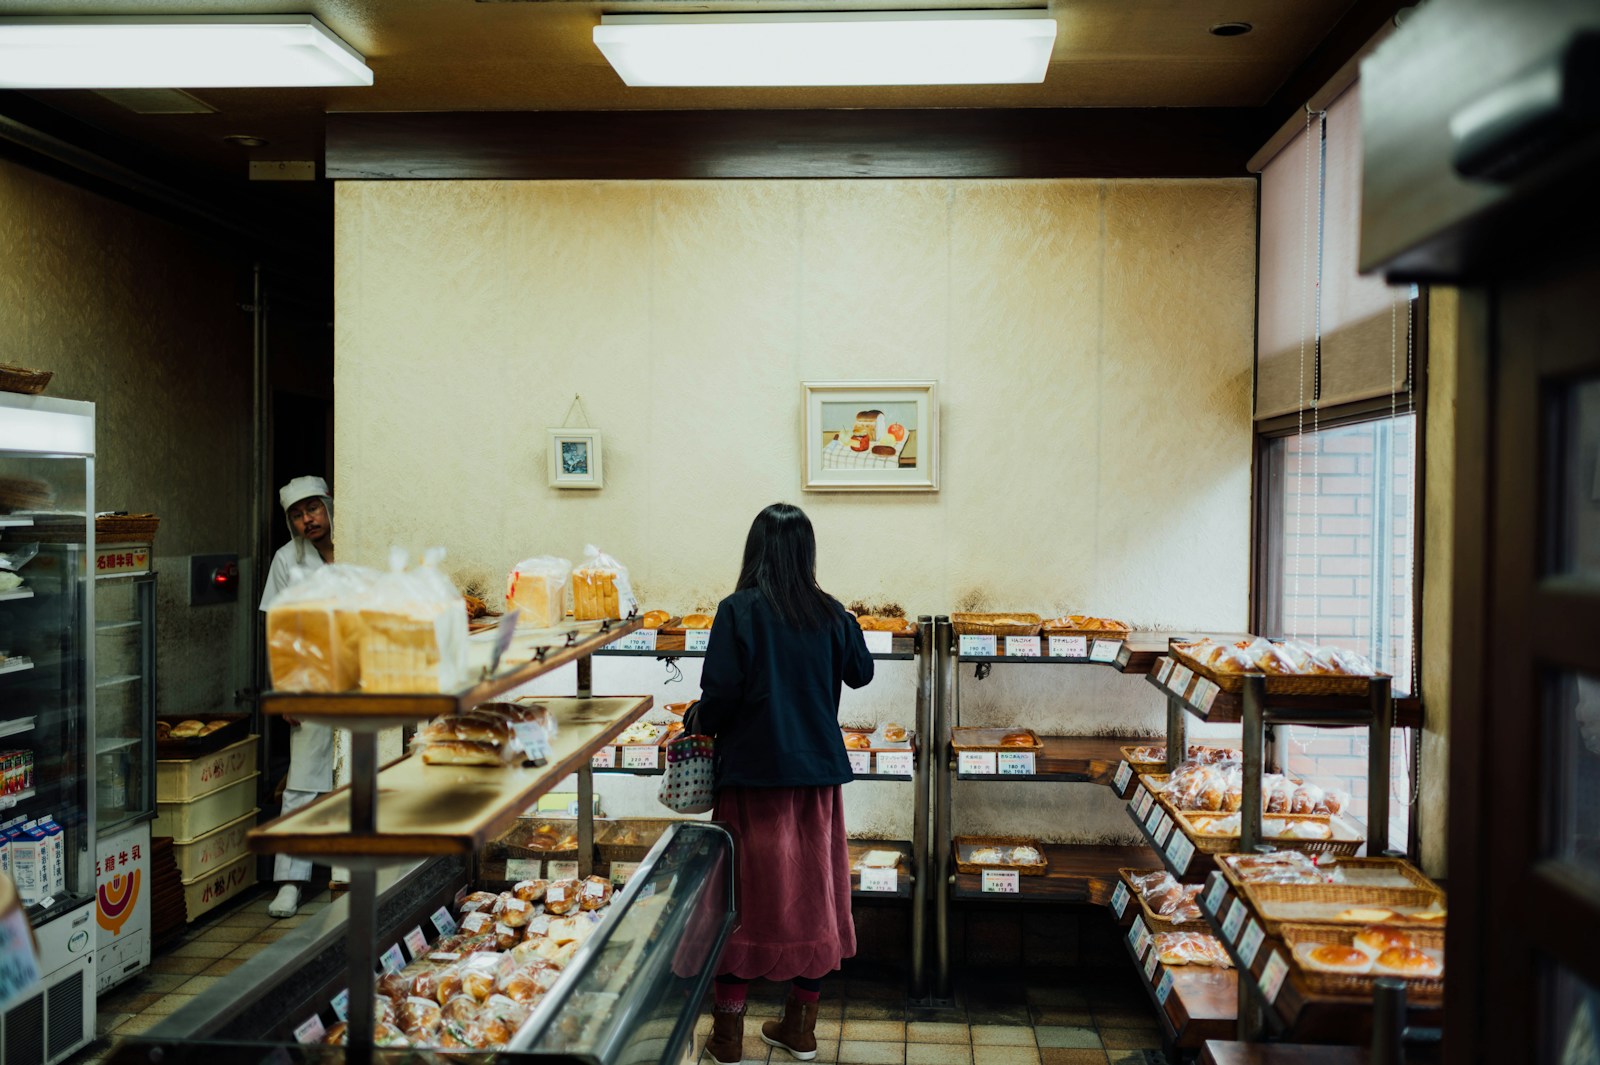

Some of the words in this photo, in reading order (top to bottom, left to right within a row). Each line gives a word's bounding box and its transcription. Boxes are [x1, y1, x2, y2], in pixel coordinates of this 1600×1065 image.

[96, 553, 134, 569] 名糖牛乳
[202, 751, 246, 782] 小松パン
[202, 864, 247, 903] 小松パン
